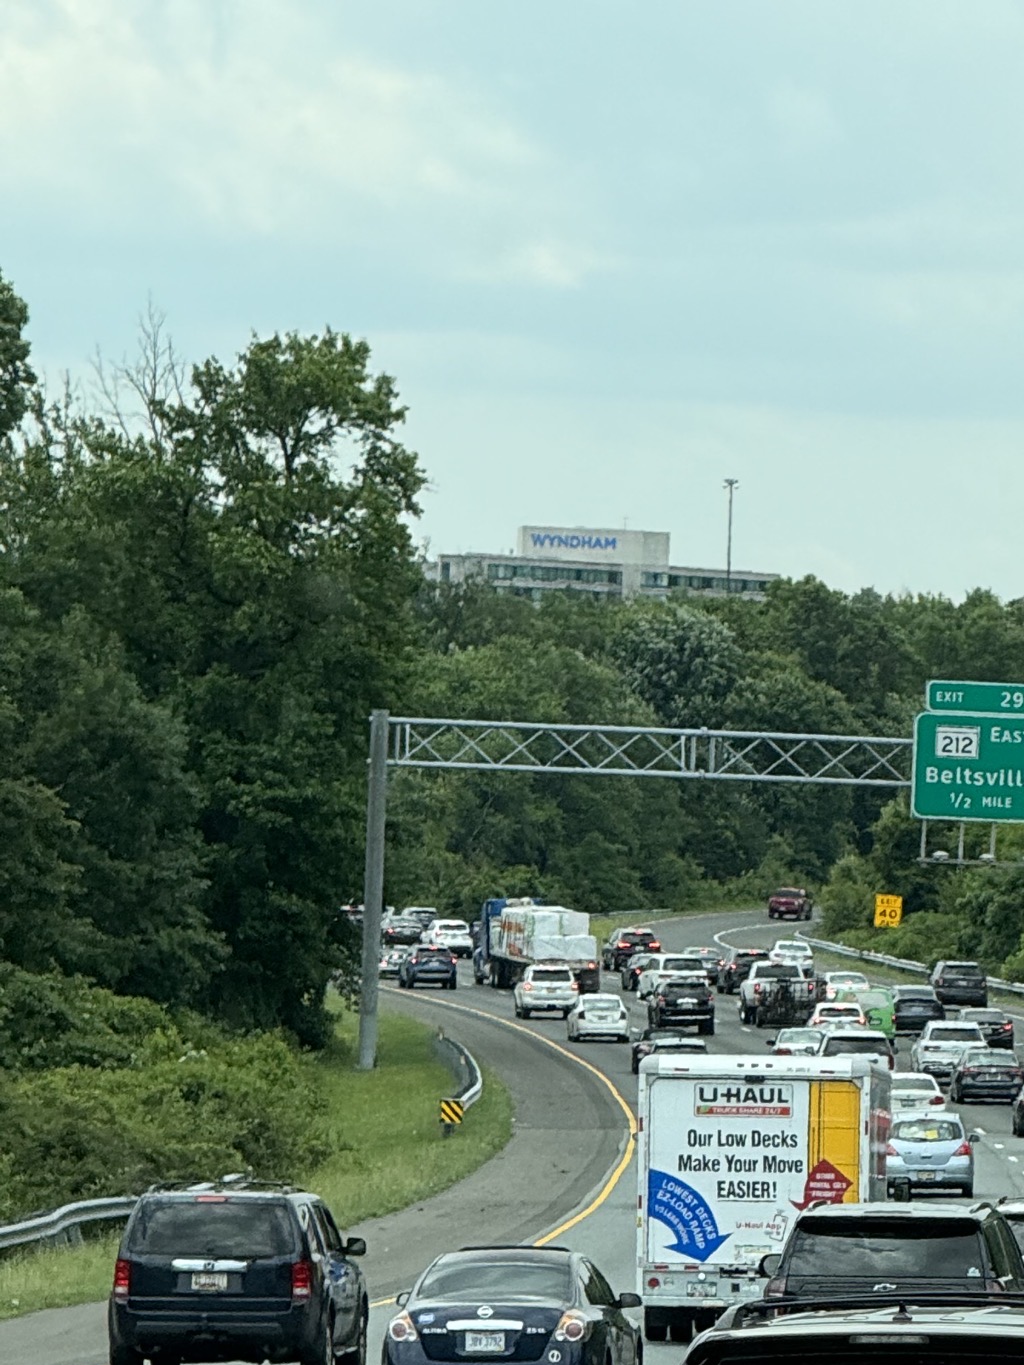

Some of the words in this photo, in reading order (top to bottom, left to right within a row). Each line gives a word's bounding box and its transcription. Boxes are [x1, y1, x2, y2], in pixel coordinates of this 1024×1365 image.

[531, 533, 616, 550] WYNDHAM
[935, 691, 964, 702] EXIT
[1000, 691, 1024, 708] 29
[941, 735, 973, 754] 212
[982, 796, 1012, 808] MILE
[879, 909, 898, 919] 40
[699, 1086, 789, 1103] U-HAUL
[687, 1129, 714, 1147] Our
[717, 1129, 747, 1148] Low
[751, 1130, 798, 1148] Decks
[678, 1154, 721, 1172] Make
[724, 1154, 759, 1172] Your
[762, 1155, 804, 1173] Move
[717, 1180, 777, 1199] EASIER!
[656, 1189, 693, 1221] EZ-LOAD
[689, 1220, 706, 1249] RAMP
[661, 1179, 699, 1208] LOWEST
[694, 1206, 717, 1240] DECKS
